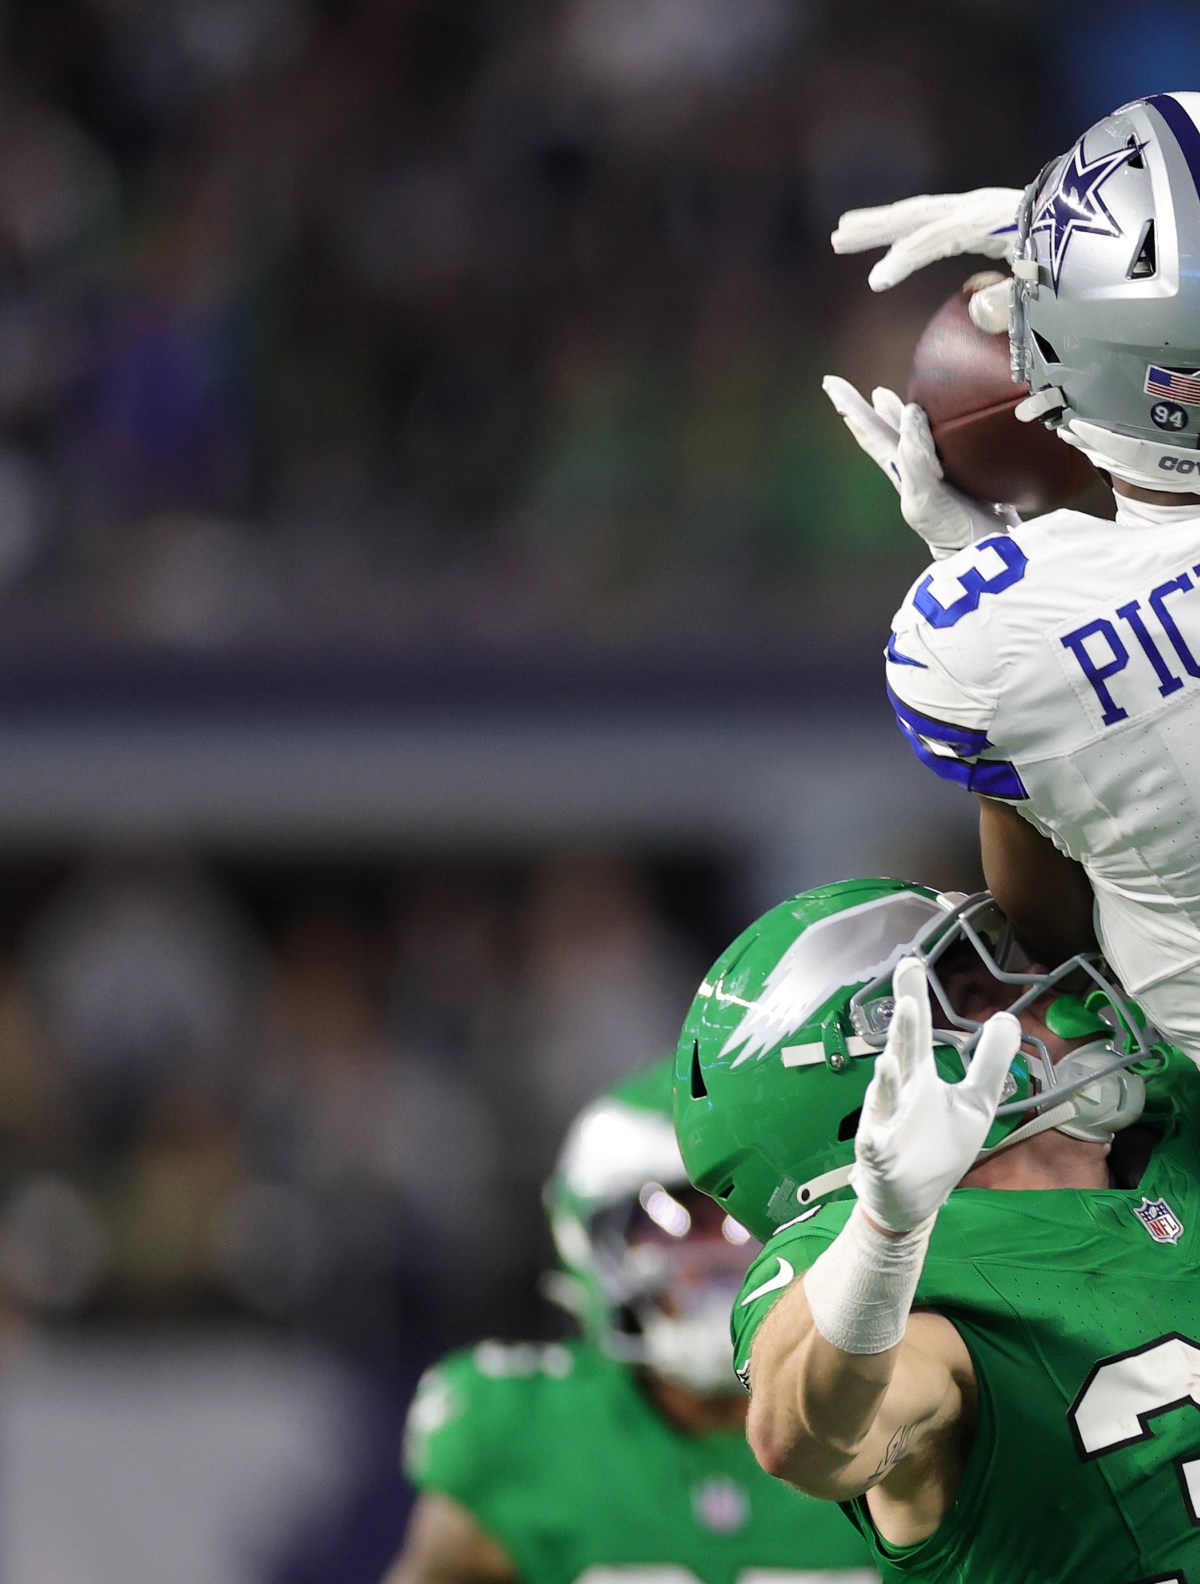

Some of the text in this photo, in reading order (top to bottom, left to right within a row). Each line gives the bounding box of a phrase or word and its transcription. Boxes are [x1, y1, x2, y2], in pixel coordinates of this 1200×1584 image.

[1154, 405, 1183, 428] 94
[912, 535, 1029, 629] 3
[1149, 1216, 1178, 1236] NFL
